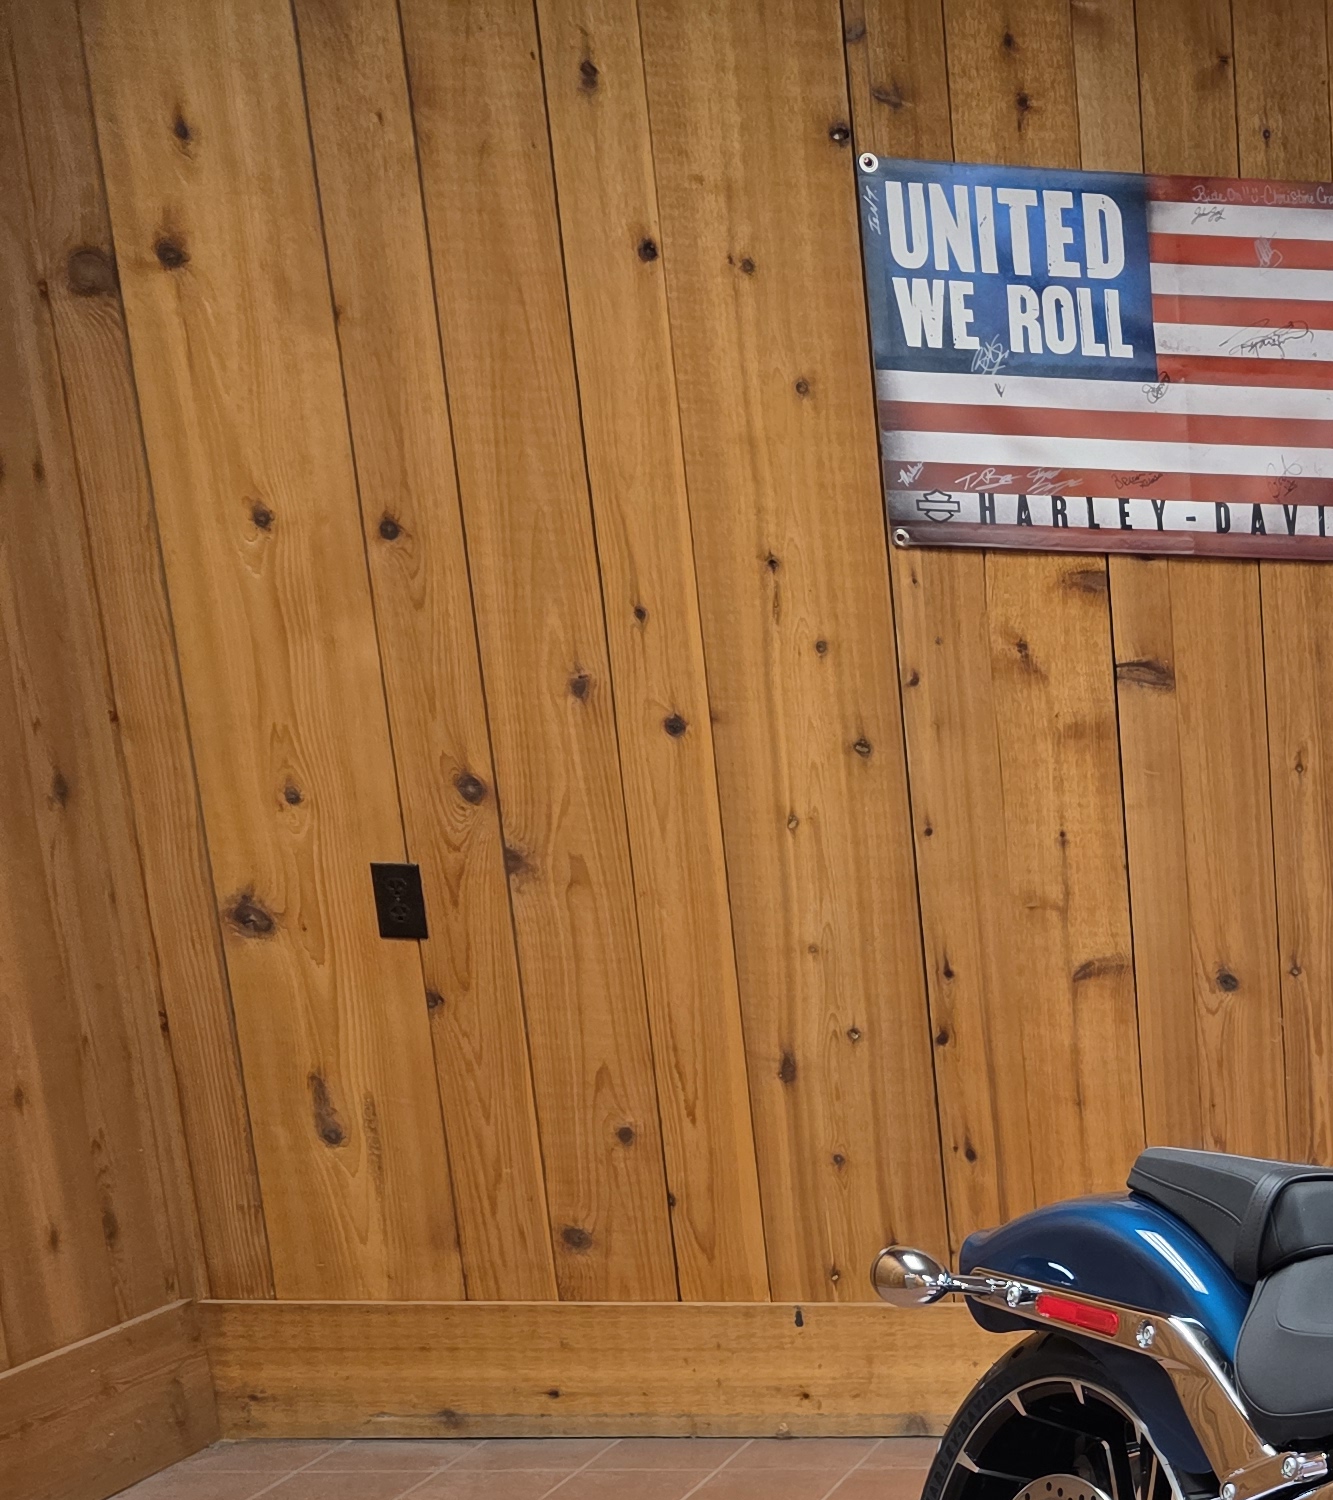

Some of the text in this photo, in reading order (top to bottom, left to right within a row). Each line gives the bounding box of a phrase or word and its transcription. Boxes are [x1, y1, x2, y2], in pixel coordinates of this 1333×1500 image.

[885, 181, 1125, 279] UNITED
[892, 277, 980, 350] WE
[1007, 284, 1134, 358] ROLL
